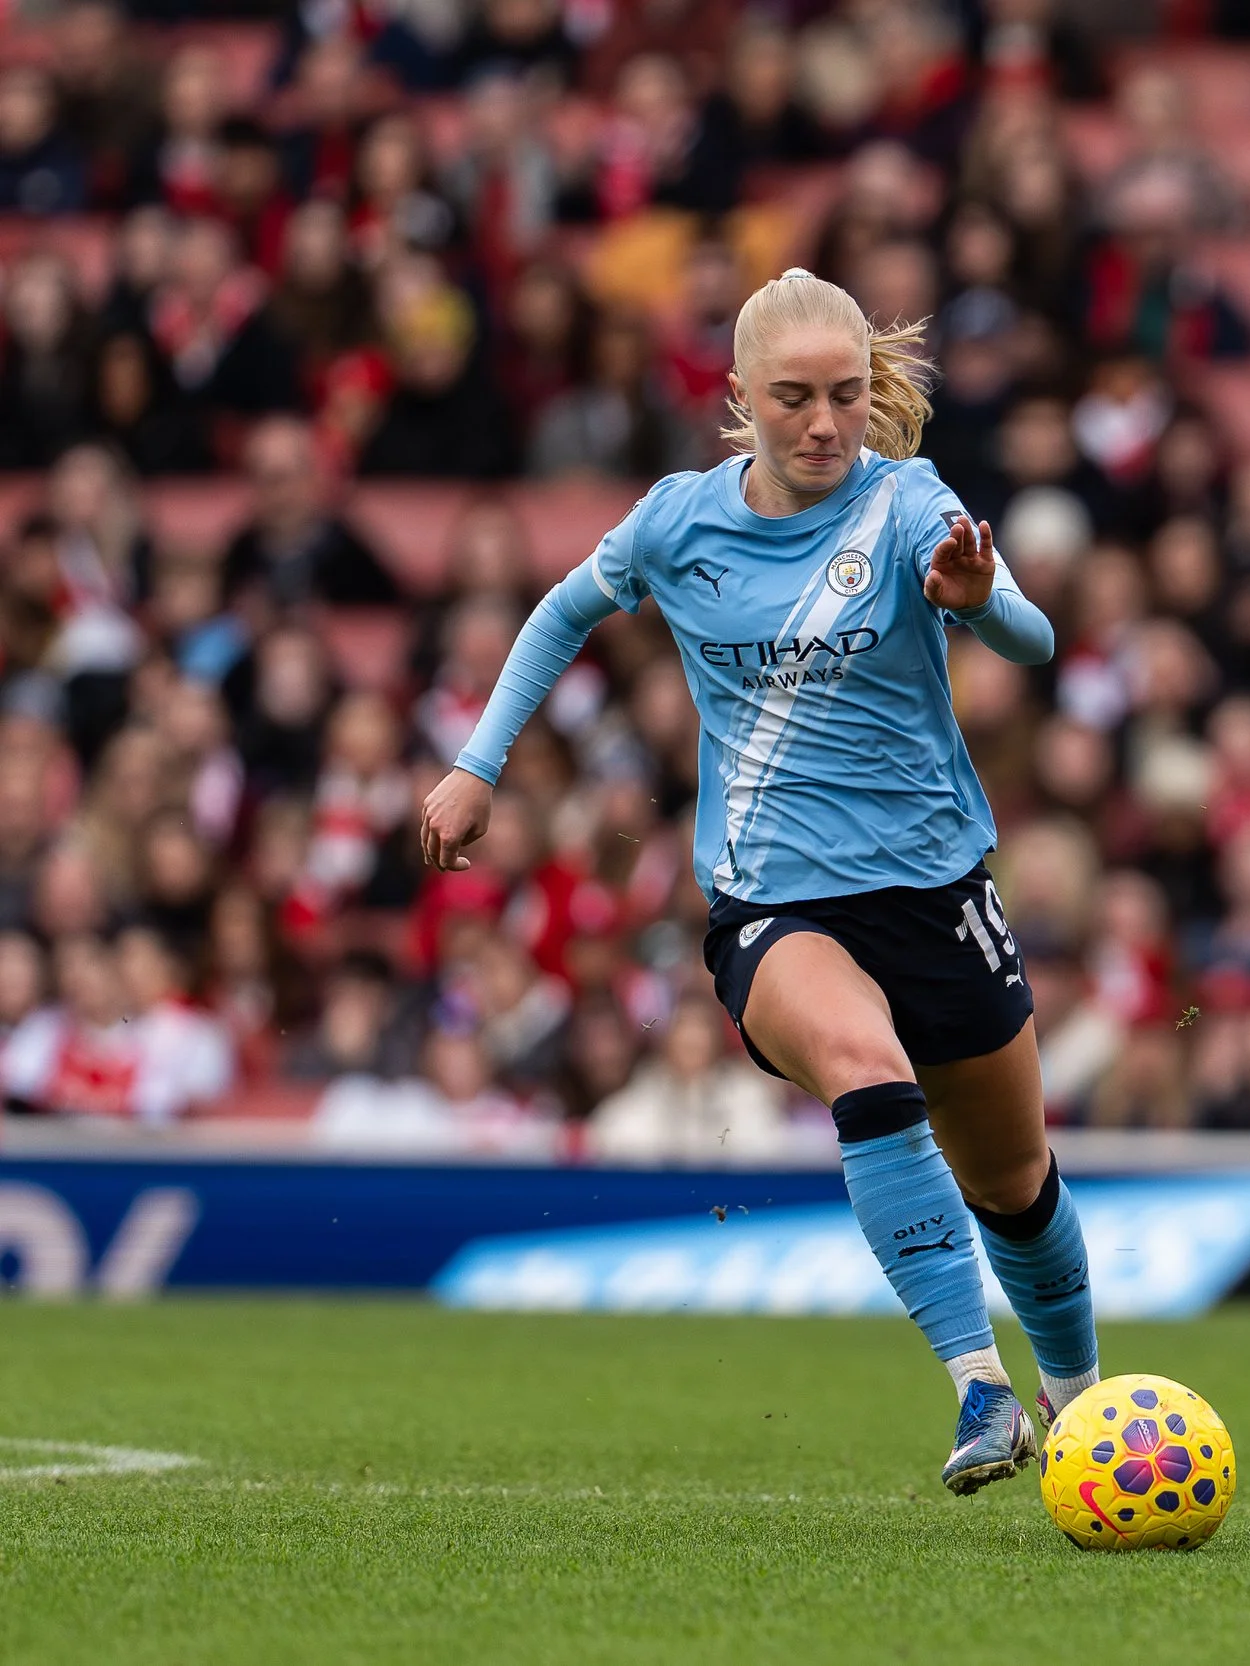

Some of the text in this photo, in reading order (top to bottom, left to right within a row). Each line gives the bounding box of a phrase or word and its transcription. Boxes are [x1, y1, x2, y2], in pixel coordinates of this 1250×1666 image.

[831, 554, 868, 570] MANCHESTER
[700, 627, 879, 667] ETIHAD
[742, 666, 844, 690] AIRWAYS
[955, 879, 1016, 973] 19
